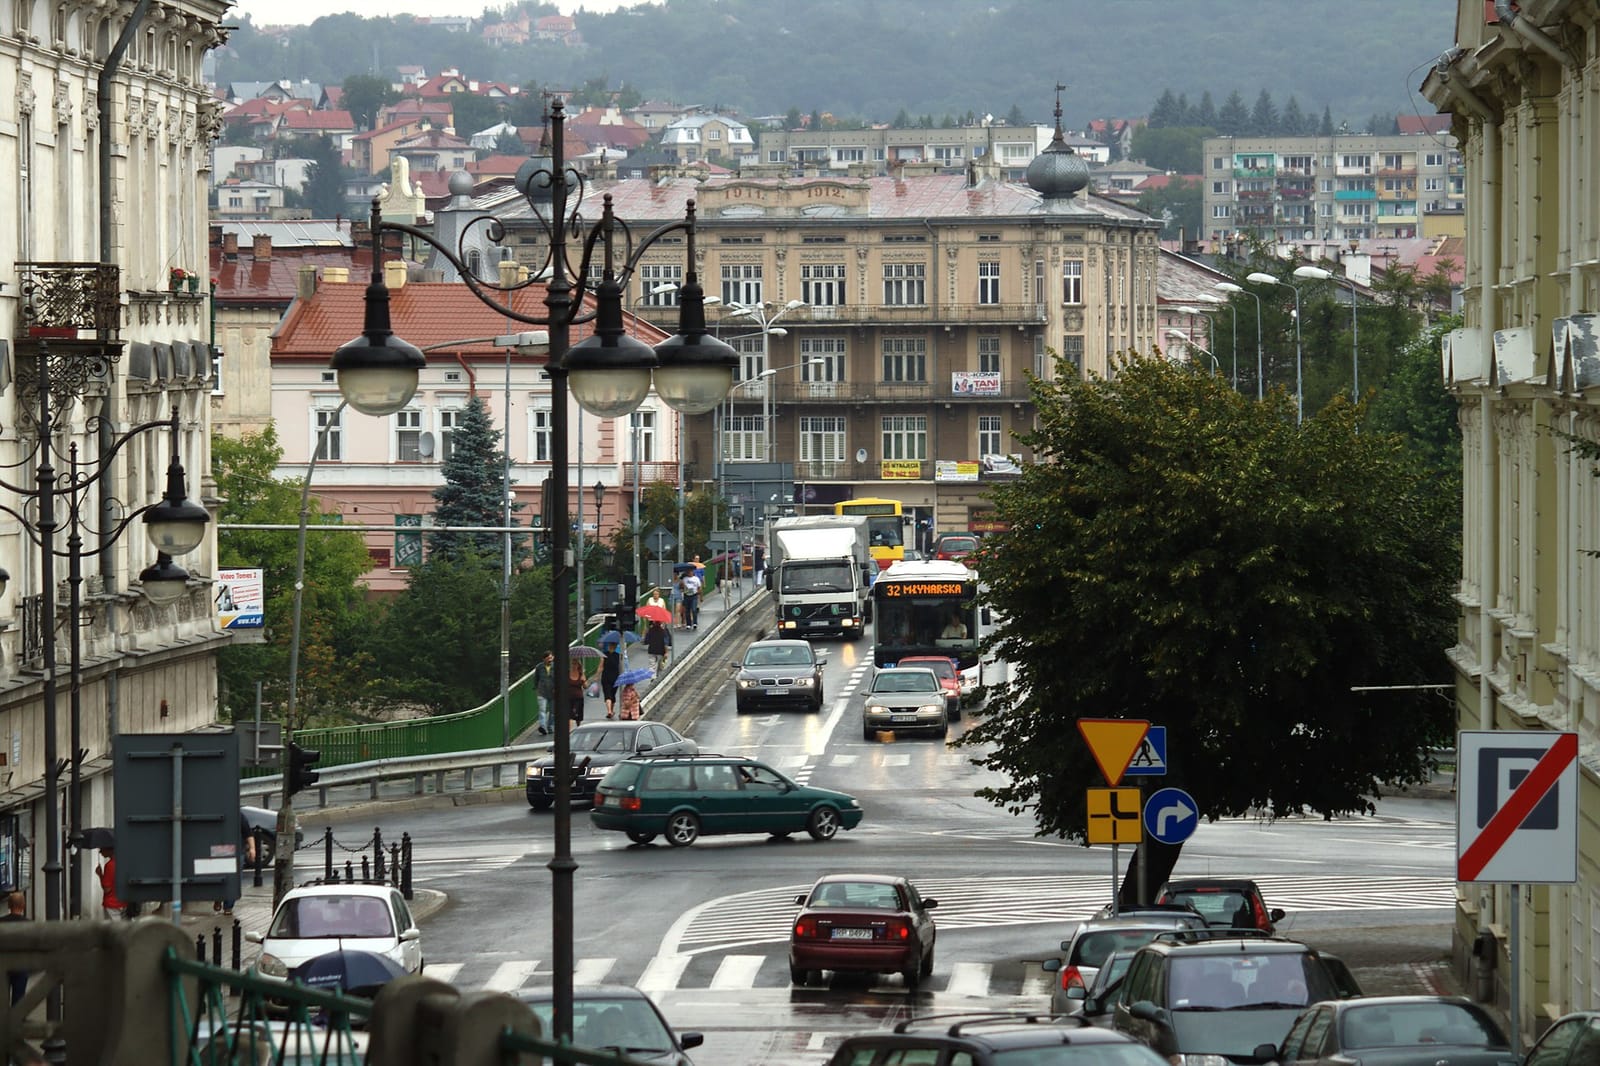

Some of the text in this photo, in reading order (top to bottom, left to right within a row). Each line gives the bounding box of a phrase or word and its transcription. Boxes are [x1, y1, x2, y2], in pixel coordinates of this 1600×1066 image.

[397, 540, 420, 562] LECH
[886, 584, 962, 597] 32 MŁYNARSKA
